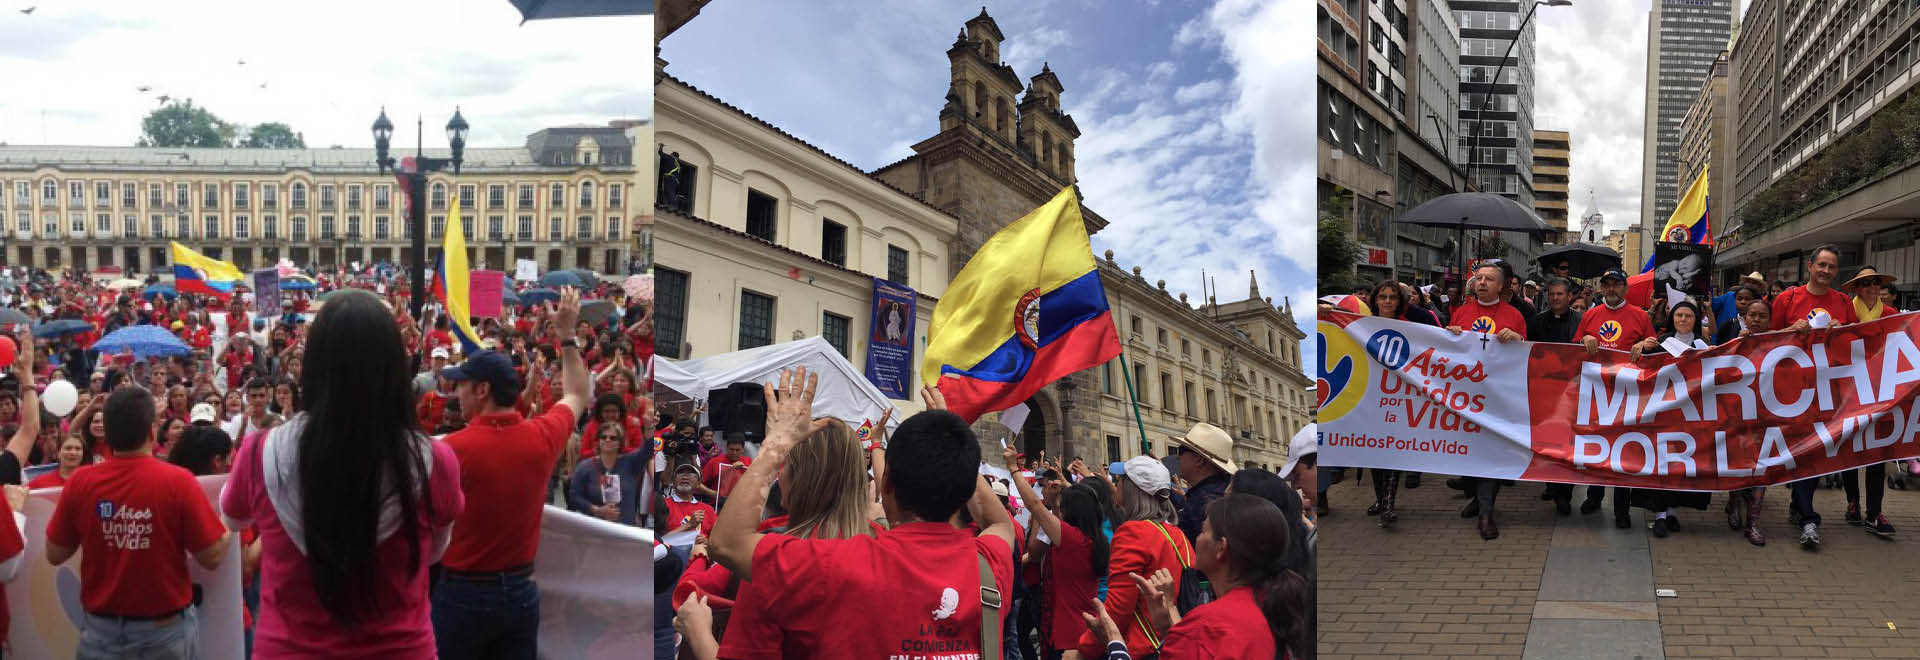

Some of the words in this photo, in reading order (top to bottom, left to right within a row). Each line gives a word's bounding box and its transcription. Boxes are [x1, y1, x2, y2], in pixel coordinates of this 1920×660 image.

[1376, 334, 1404, 367] 10
[1402, 346, 1488, 383] Años
[1379, 369, 1486, 413] Unidos
[1576, 330, 1920, 426] MARCHA
[1379, 396, 1402, 408] por
[1404, 398, 1481, 433] Vida
[1384, 411, 1397, 423] la
[1328, 432, 1469, 455] UnidosPorLaVida
[1573, 431, 1697, 477] POR
[1715, 426, 1797, 477] LA
[102, 519, 152, 535] Unidos
[115, 534, 150, 549] Vida
